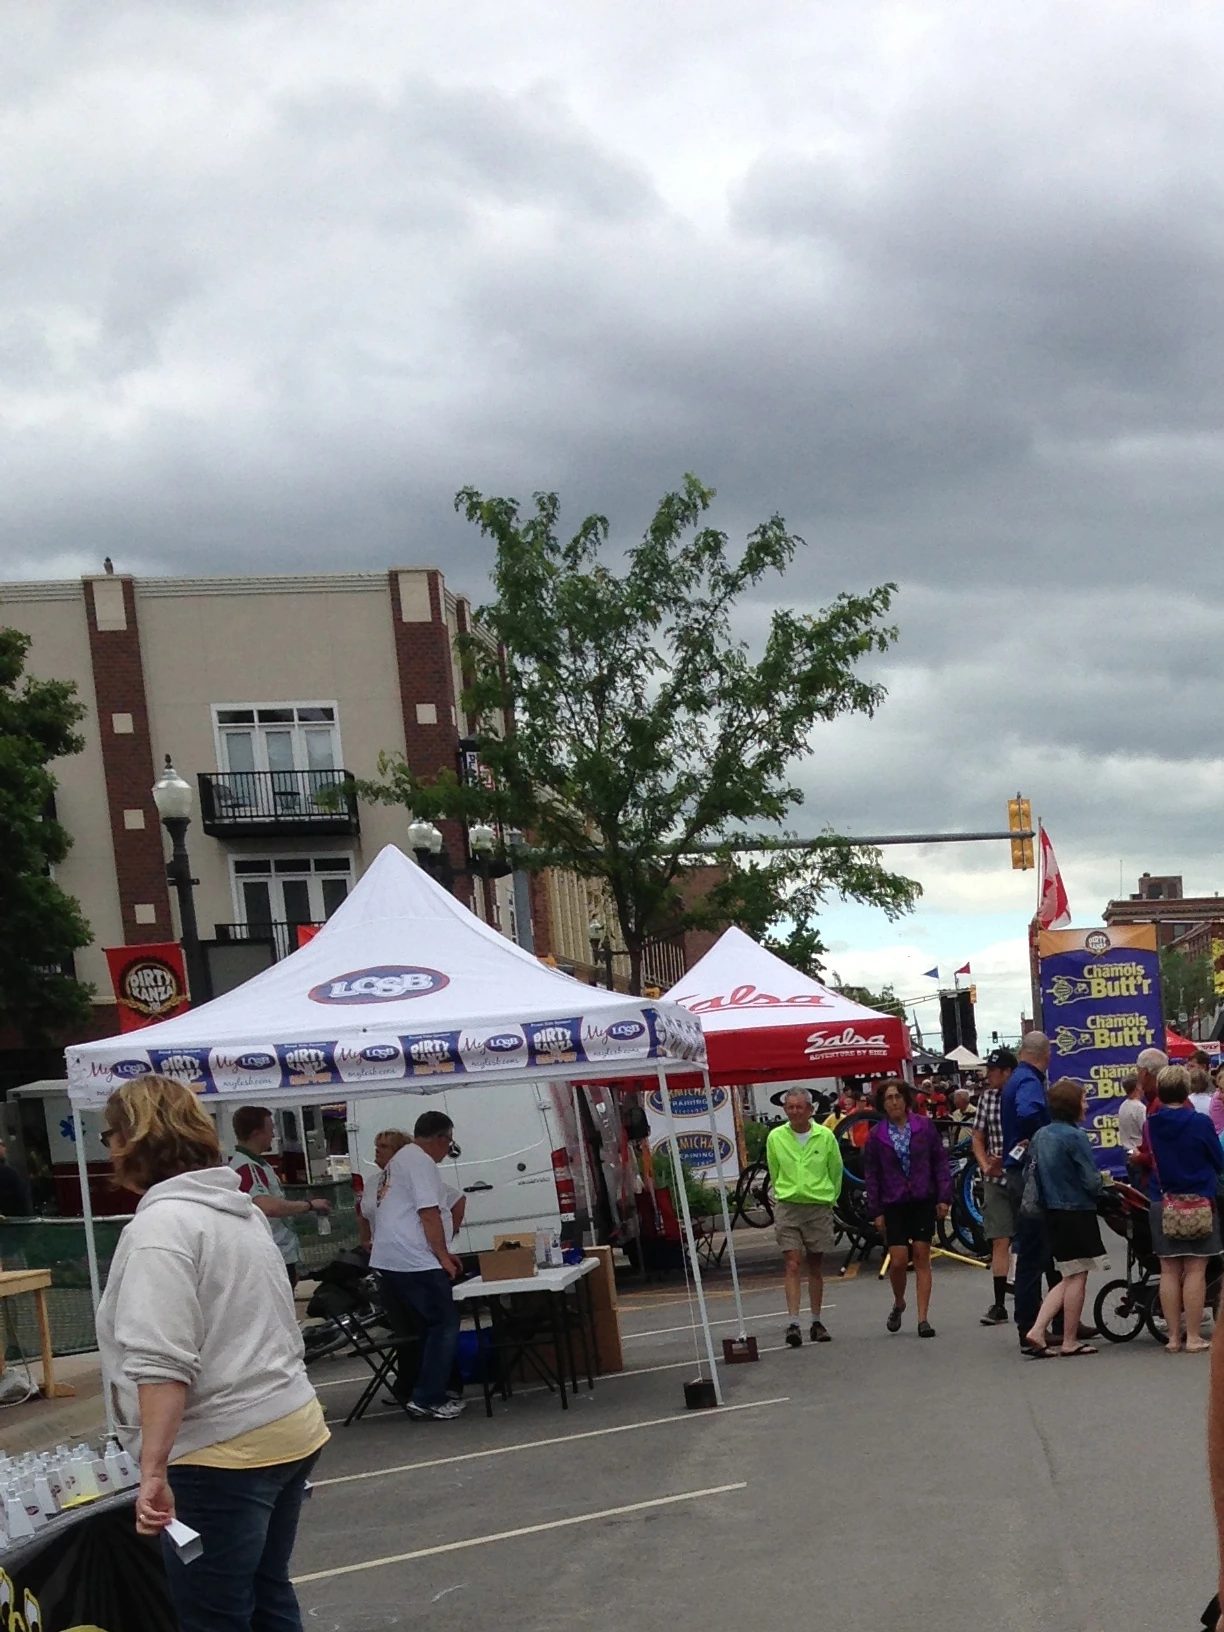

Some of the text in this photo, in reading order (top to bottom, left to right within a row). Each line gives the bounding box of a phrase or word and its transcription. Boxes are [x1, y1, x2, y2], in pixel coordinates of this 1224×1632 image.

[130, 969, 171, 987] DIRTY
[1084, 962, 1145, 980] Chamois
[132, 986, 173, 1001] KANZA
[1091, 977, 1152, 998] Butt'r
[1086, 1012, 1148, 1029] Chamois
[533, 1027, 572, 1041] DIRTY
[804, 1028, 890, 1054] Salsa
[1094, 1027, 1155, 1049] Butt'r
[411, 1039, 450, 1053] DIRTY
[161, 1055, 200, 1071] DIRTY
[285, 1049, 325, 1062] DIRTY
[1090, 1065, 1138, 1079] Chamo
